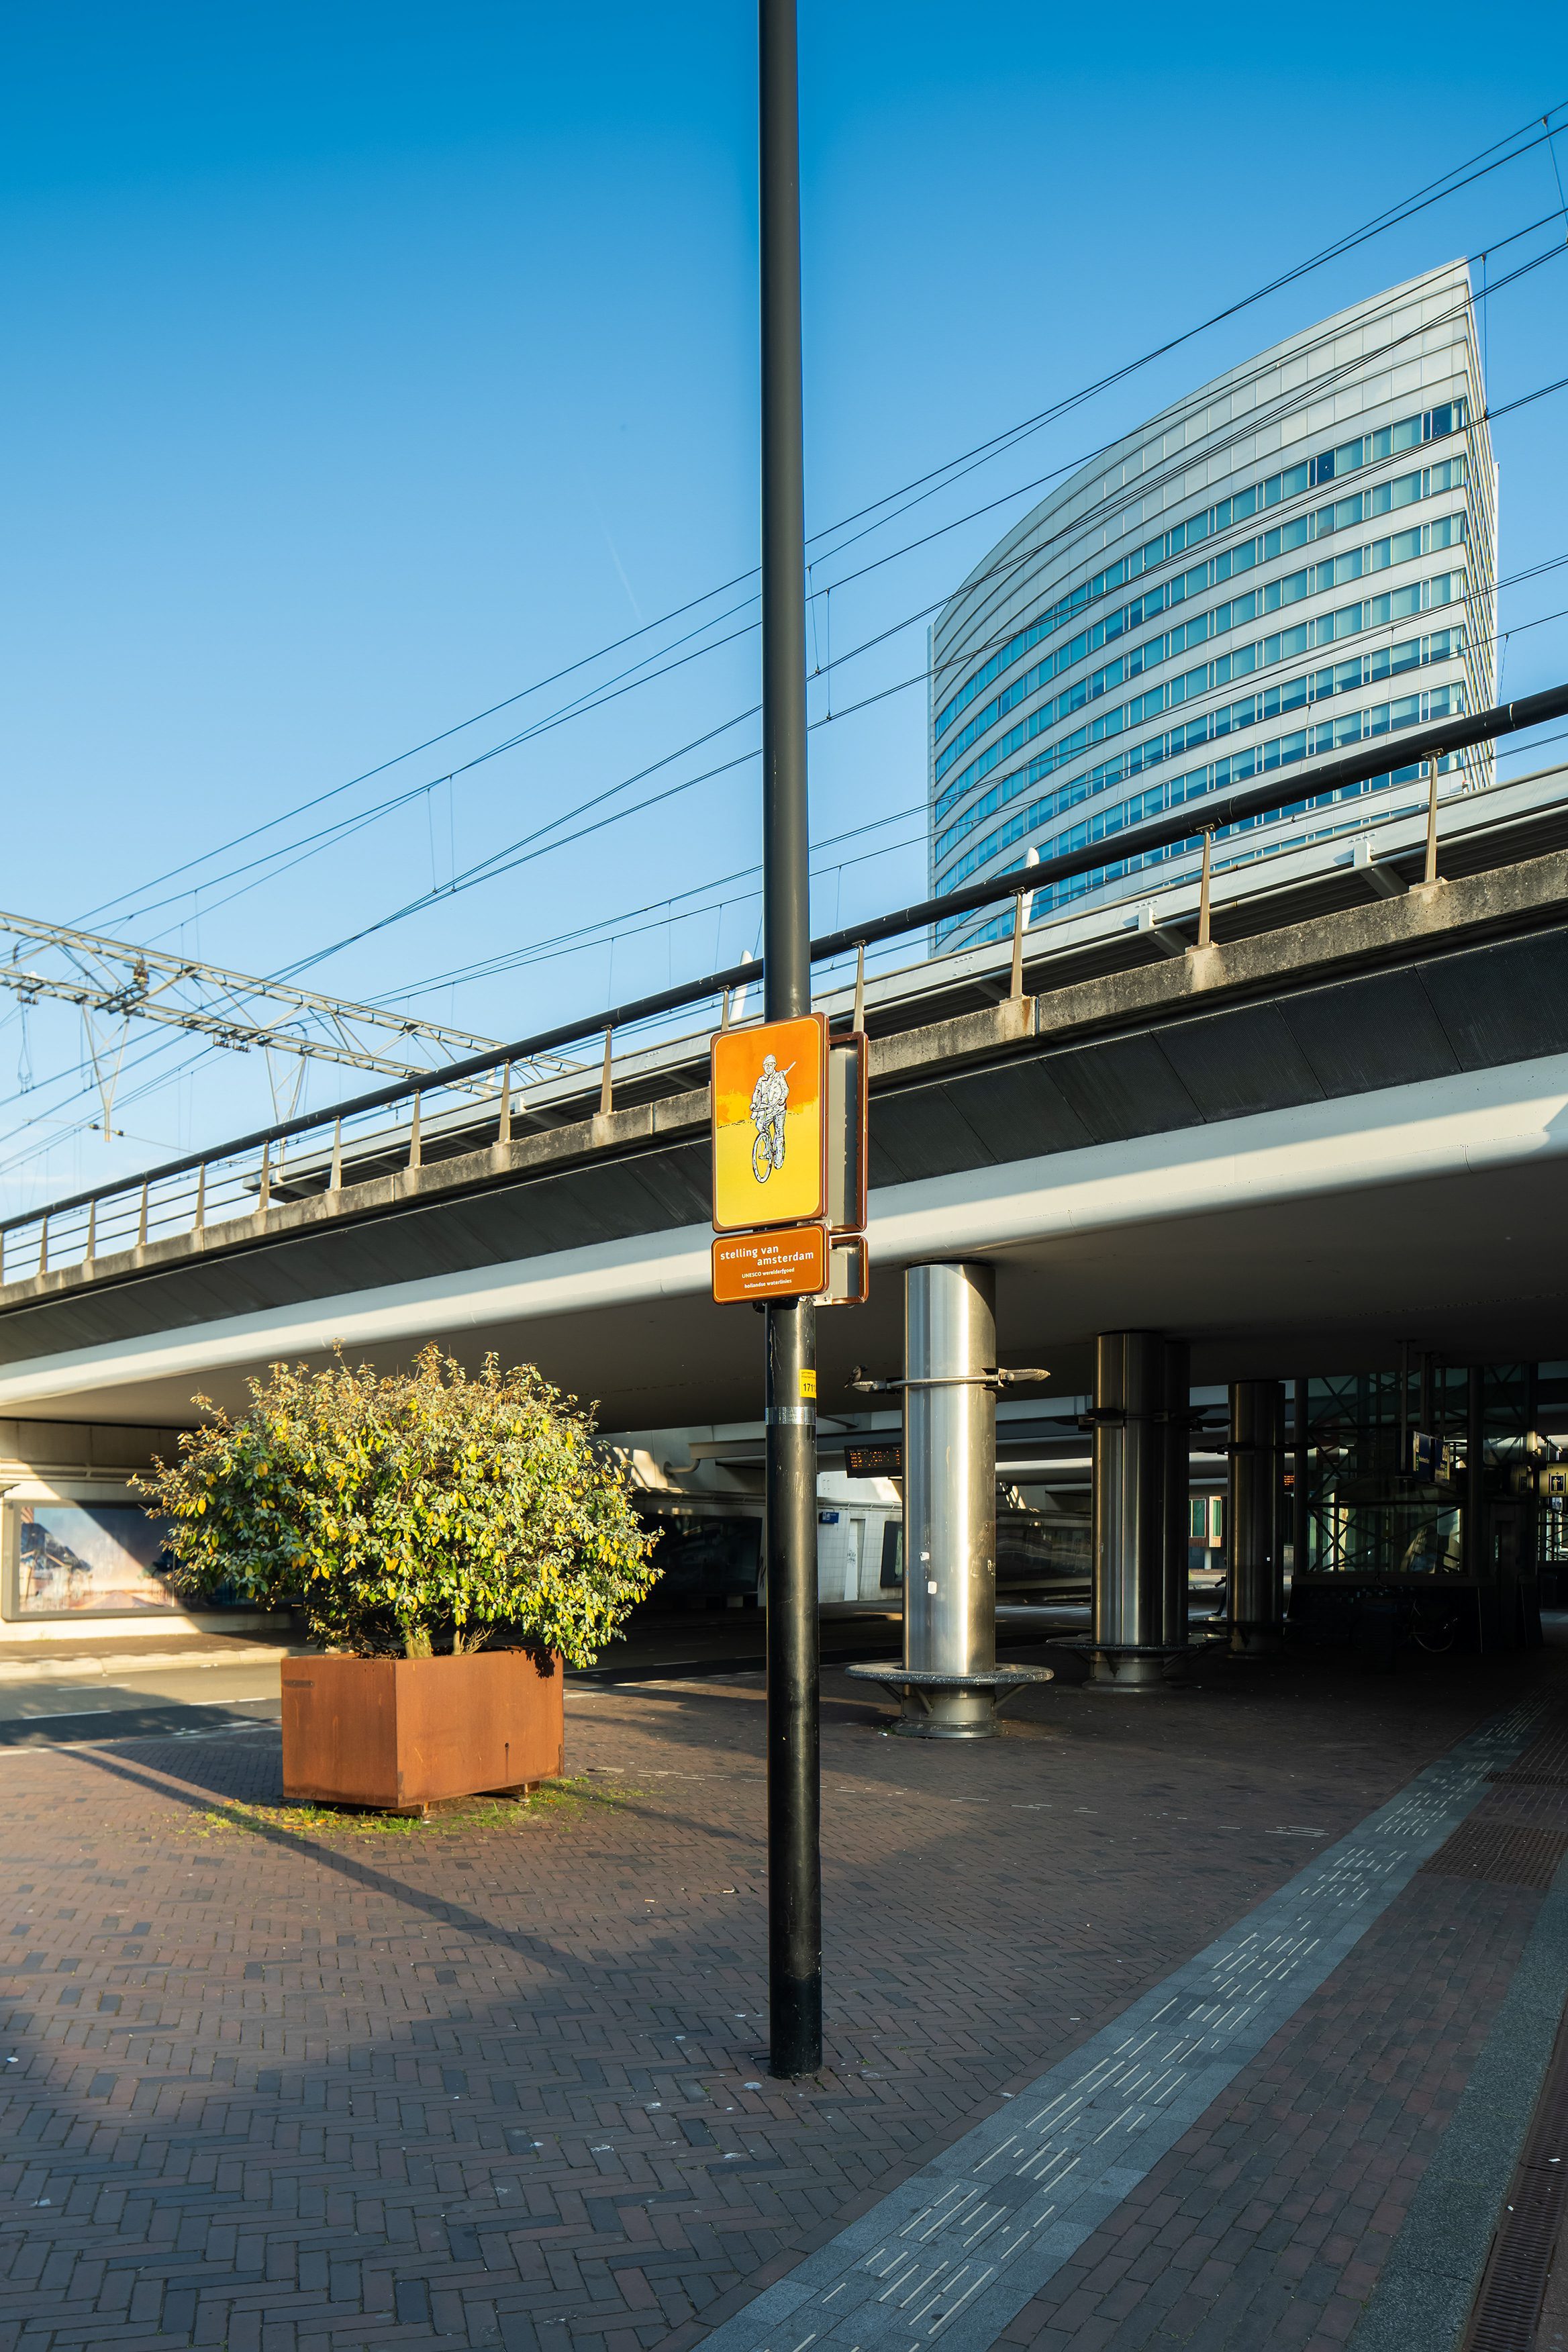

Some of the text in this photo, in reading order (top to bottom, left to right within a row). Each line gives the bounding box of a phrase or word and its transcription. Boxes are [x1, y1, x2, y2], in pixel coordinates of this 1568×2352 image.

[720, 1245, 779, 1261] stelling van
[757, 1251, 814, 1266] amsterdam
[763, 1267, 795, 1275] werelderfgoed
